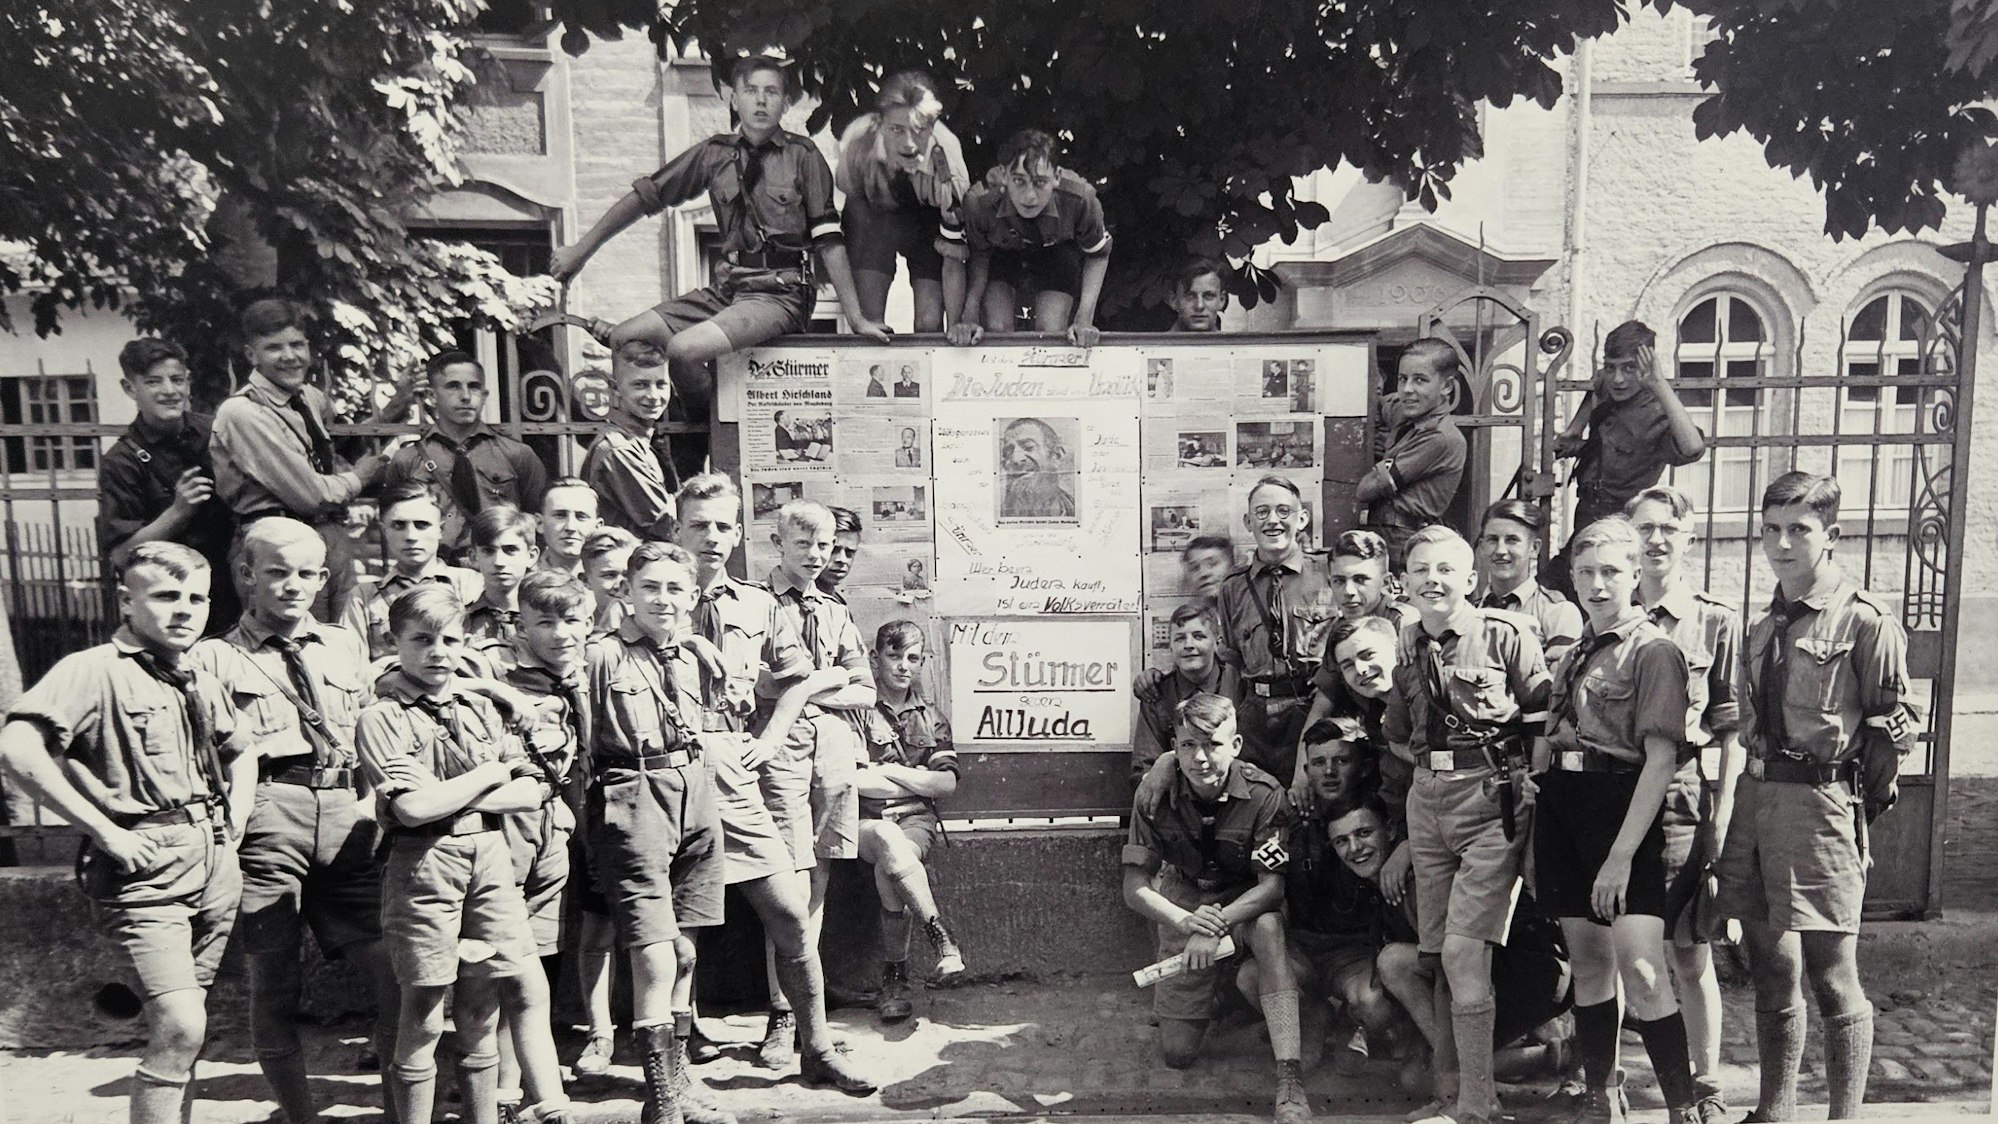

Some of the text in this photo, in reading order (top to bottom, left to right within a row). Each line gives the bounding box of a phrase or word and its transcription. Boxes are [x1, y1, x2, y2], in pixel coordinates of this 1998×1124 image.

[772, 359, 829, 377] Stürmer
[747, 389, 833, 400] Albert Hirschland
[977, 651, 1118, 688] Stürmer
